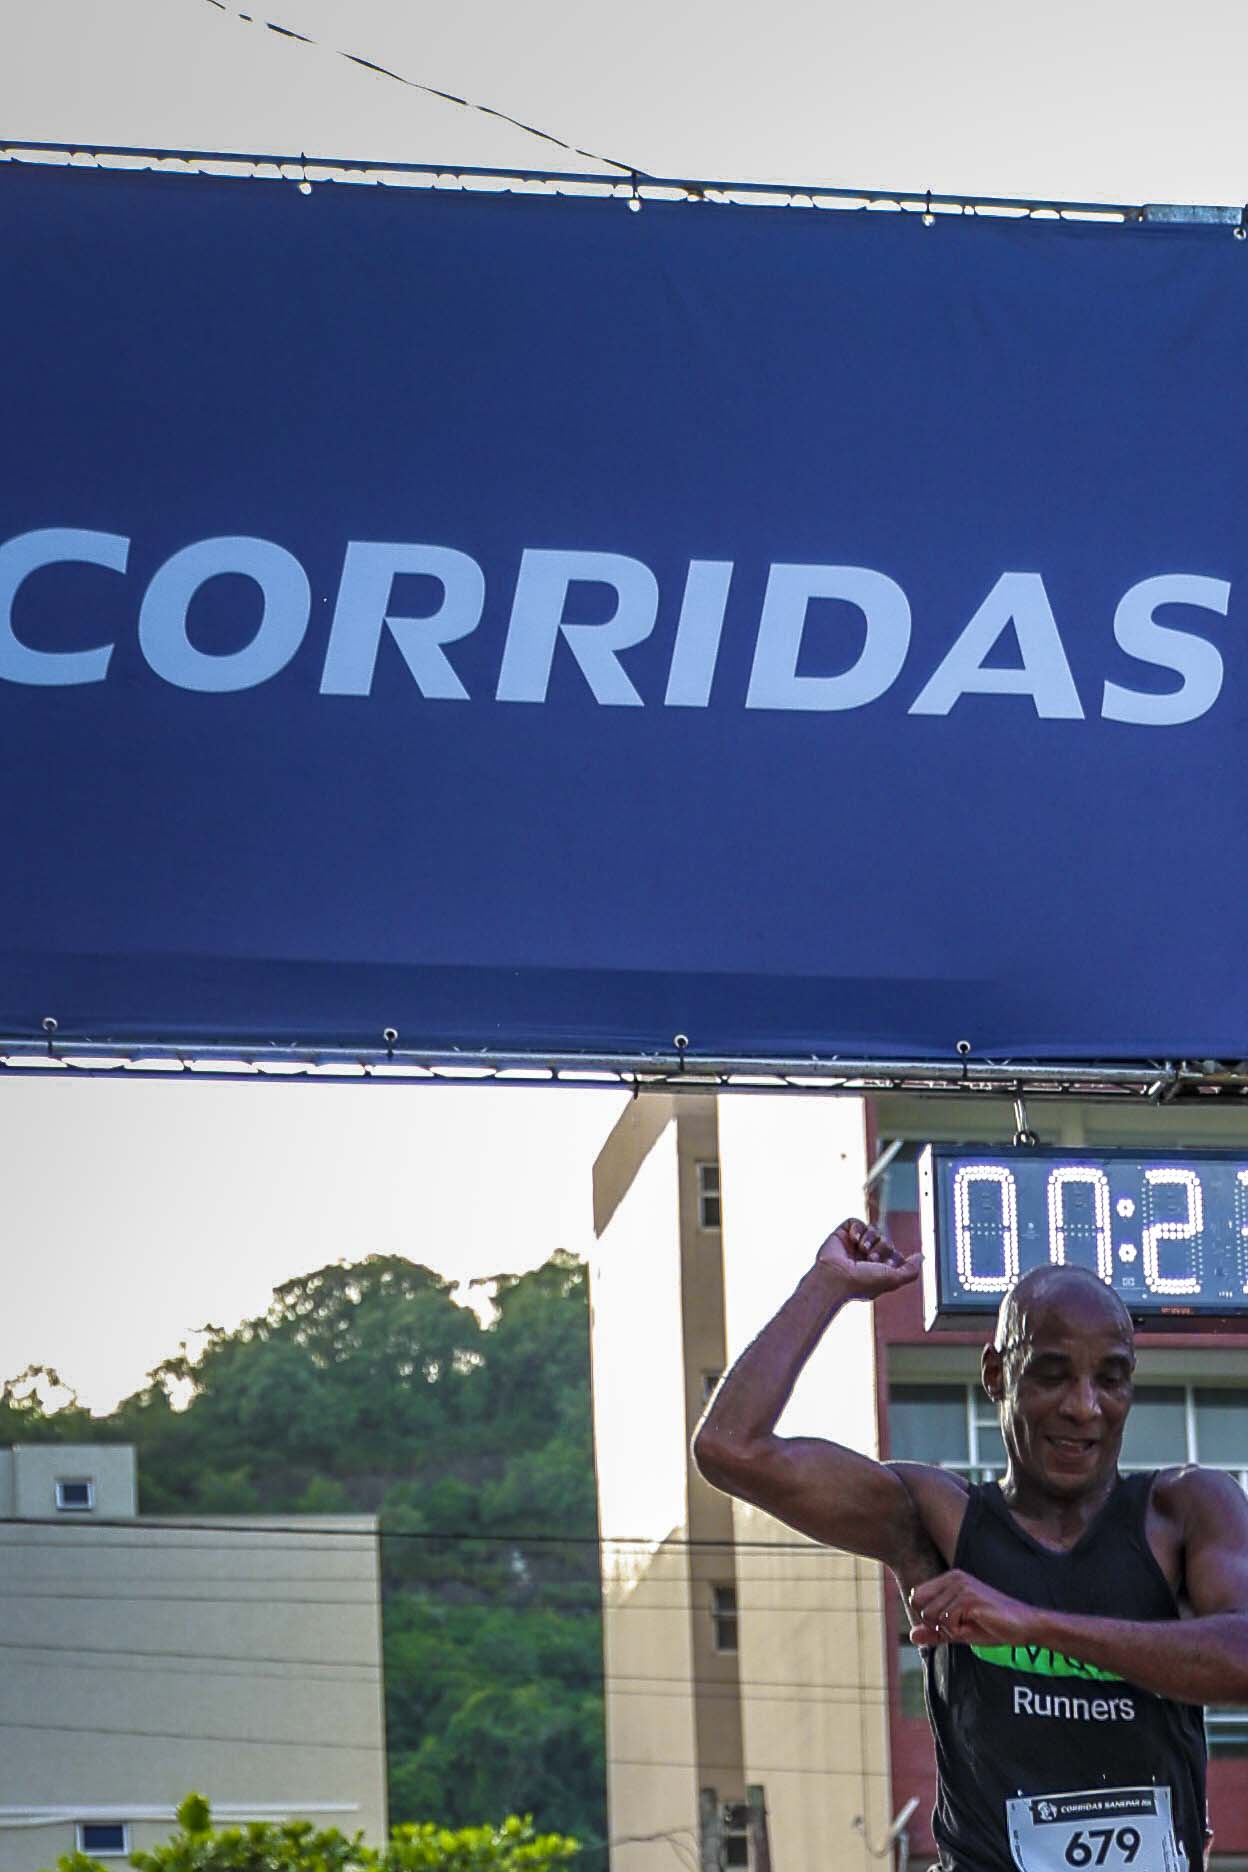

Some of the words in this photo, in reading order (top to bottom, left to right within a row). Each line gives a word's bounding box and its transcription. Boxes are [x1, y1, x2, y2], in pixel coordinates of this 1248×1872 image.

[0, 527, 1231, 726] CORRIDAS
[1013, 1685, 1136, 1721] Runners
[1064, 1825, 1142, 1869] 679
